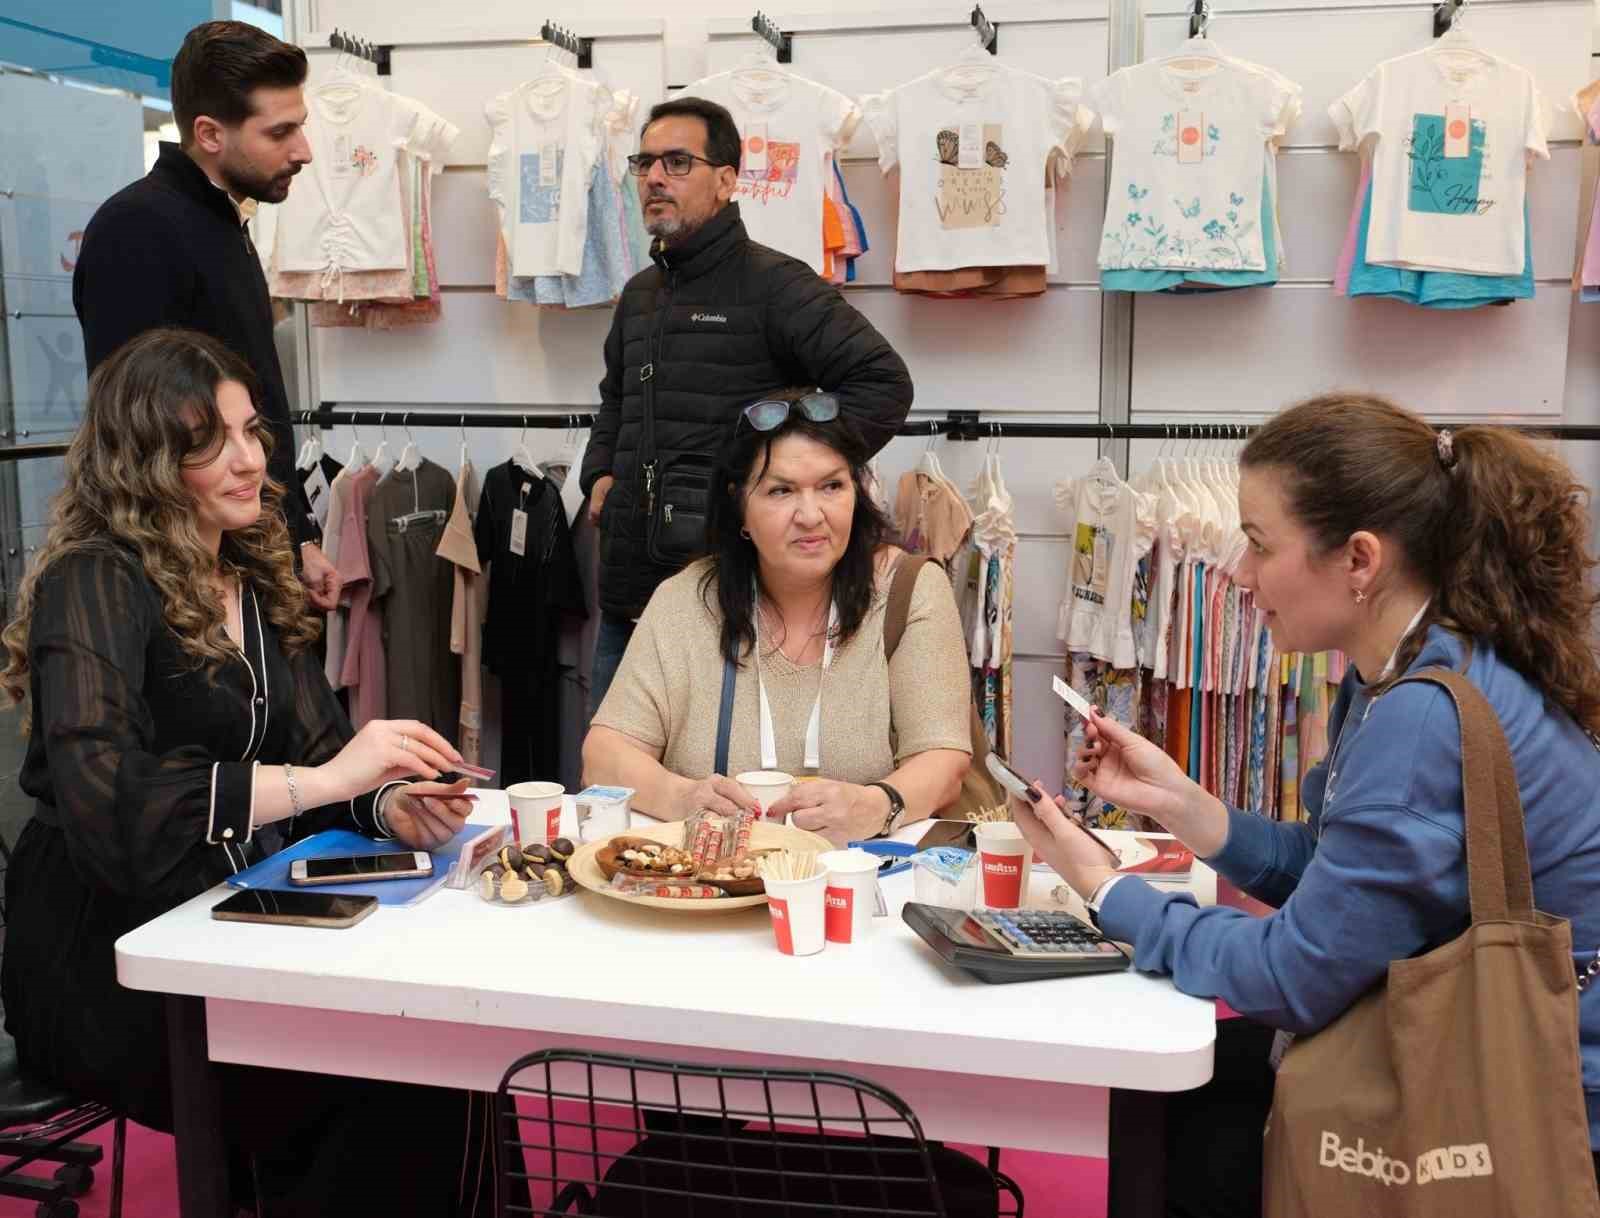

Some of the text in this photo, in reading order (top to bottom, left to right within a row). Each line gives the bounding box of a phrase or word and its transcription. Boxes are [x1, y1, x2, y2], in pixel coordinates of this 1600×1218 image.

[1444, 184, 1497, 215] Happy
[697, 312, 728, 323] Columbia
[825, 893, 848, 906] AZZA
[1417, 1146, 1489, 1182] KIDS
